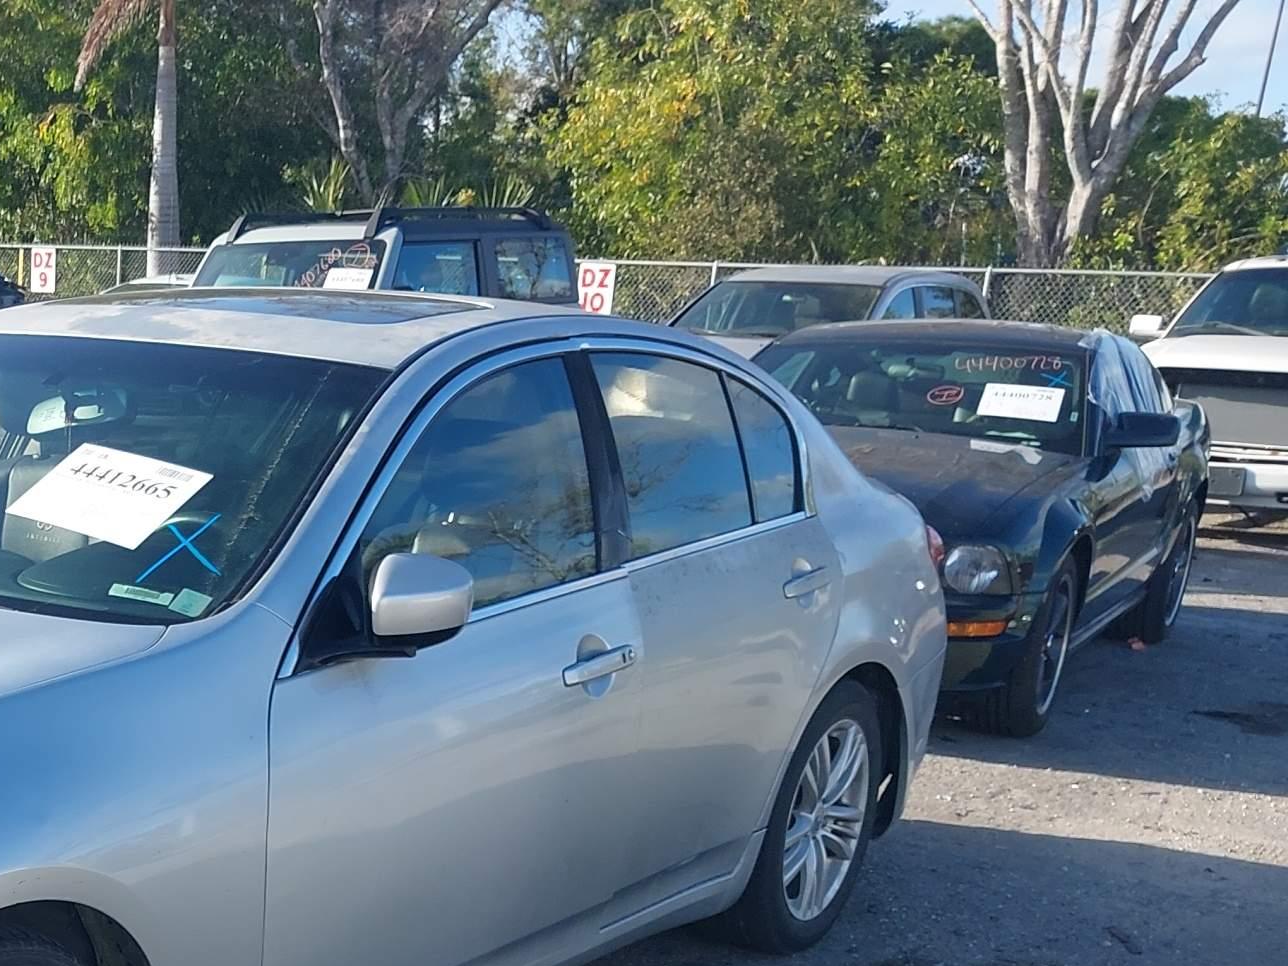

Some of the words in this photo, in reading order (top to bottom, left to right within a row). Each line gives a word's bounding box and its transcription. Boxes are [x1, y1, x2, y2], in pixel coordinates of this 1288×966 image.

[34, 252, 53, 268] DZ
[39, 271, 47, 288] 9
[582, 268, 611, 288] DZ
[69, 463, 178, 499] 44412665
